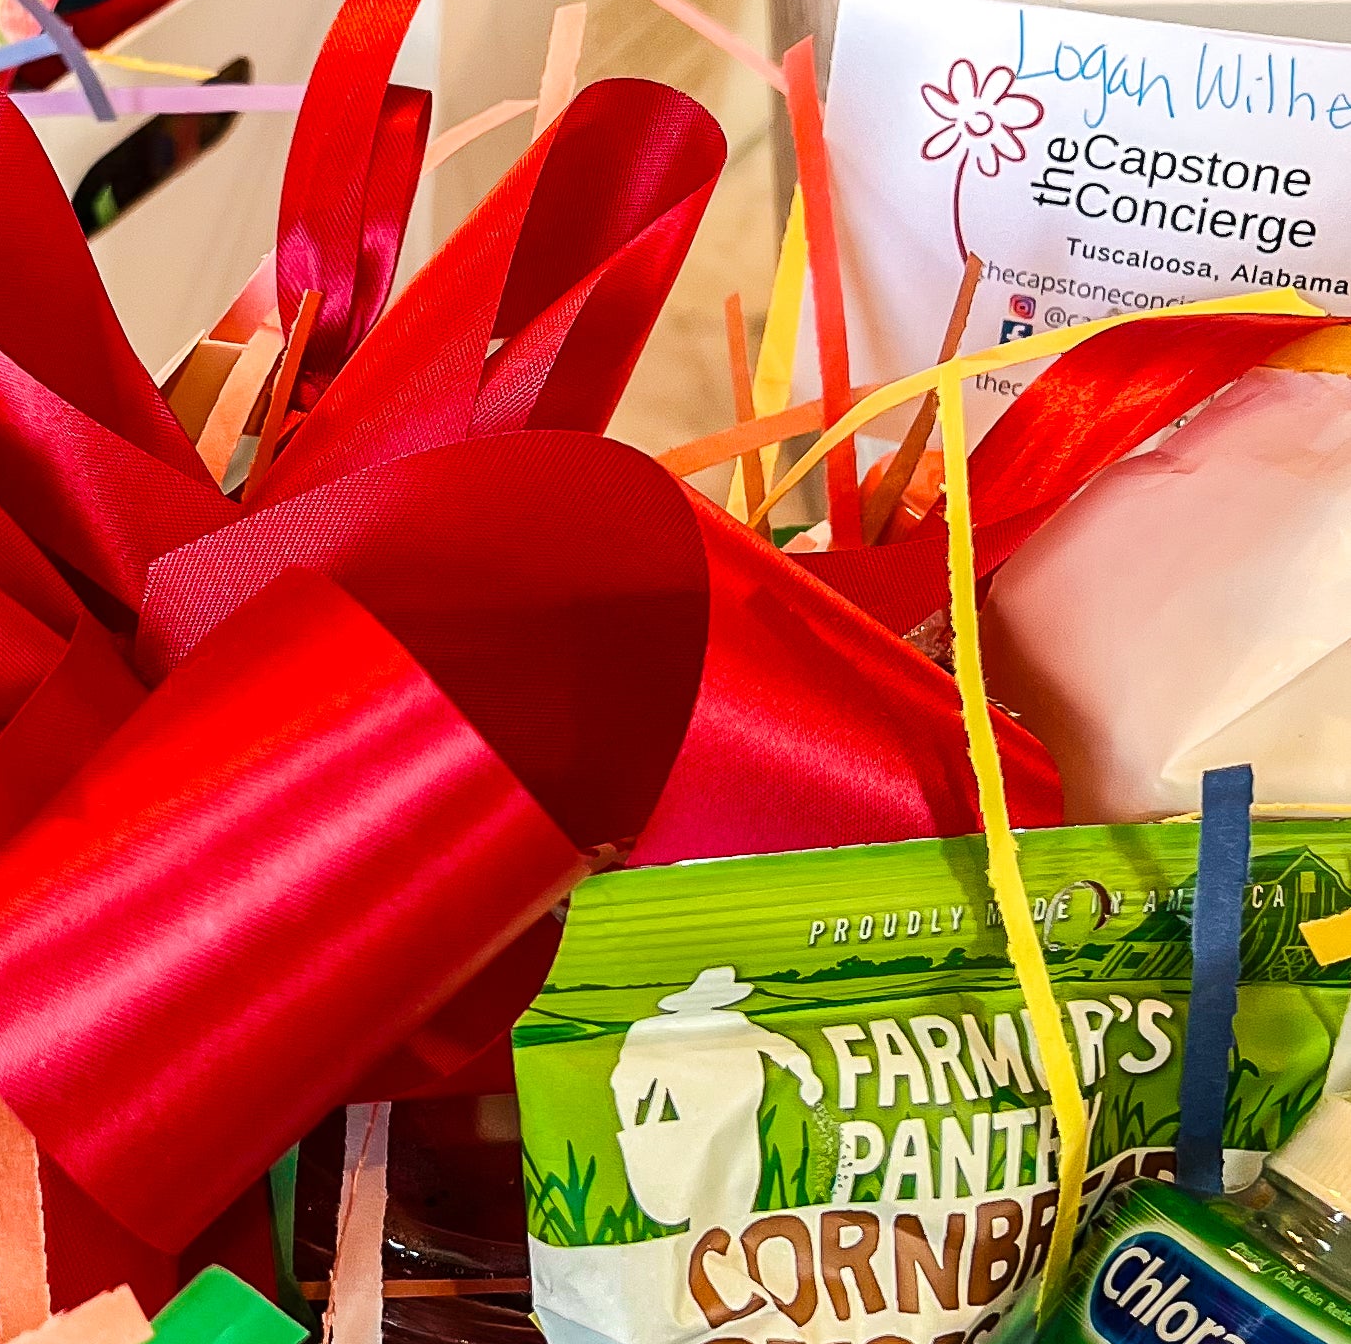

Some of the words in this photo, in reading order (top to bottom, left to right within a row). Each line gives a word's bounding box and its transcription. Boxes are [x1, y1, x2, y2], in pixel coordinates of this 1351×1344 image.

[1016, 9, 1175, 128] Logan
[1031, 136, 1079, 207] the
[1083, 134, 1312, 198] Capstone
[1075, 182, 1318, 254] Concierge
[1066, 237, 1220, 282] Tuscaloosa,
[1231, 263, 1350, 296] Alabama
[808, 903, 964, 946] PROUDLY
[986, 890, 1070, 927] MDE
[1141, 883, 1287, 916] AMCA
[822, 994, 1174, 1111] FARMR'S
